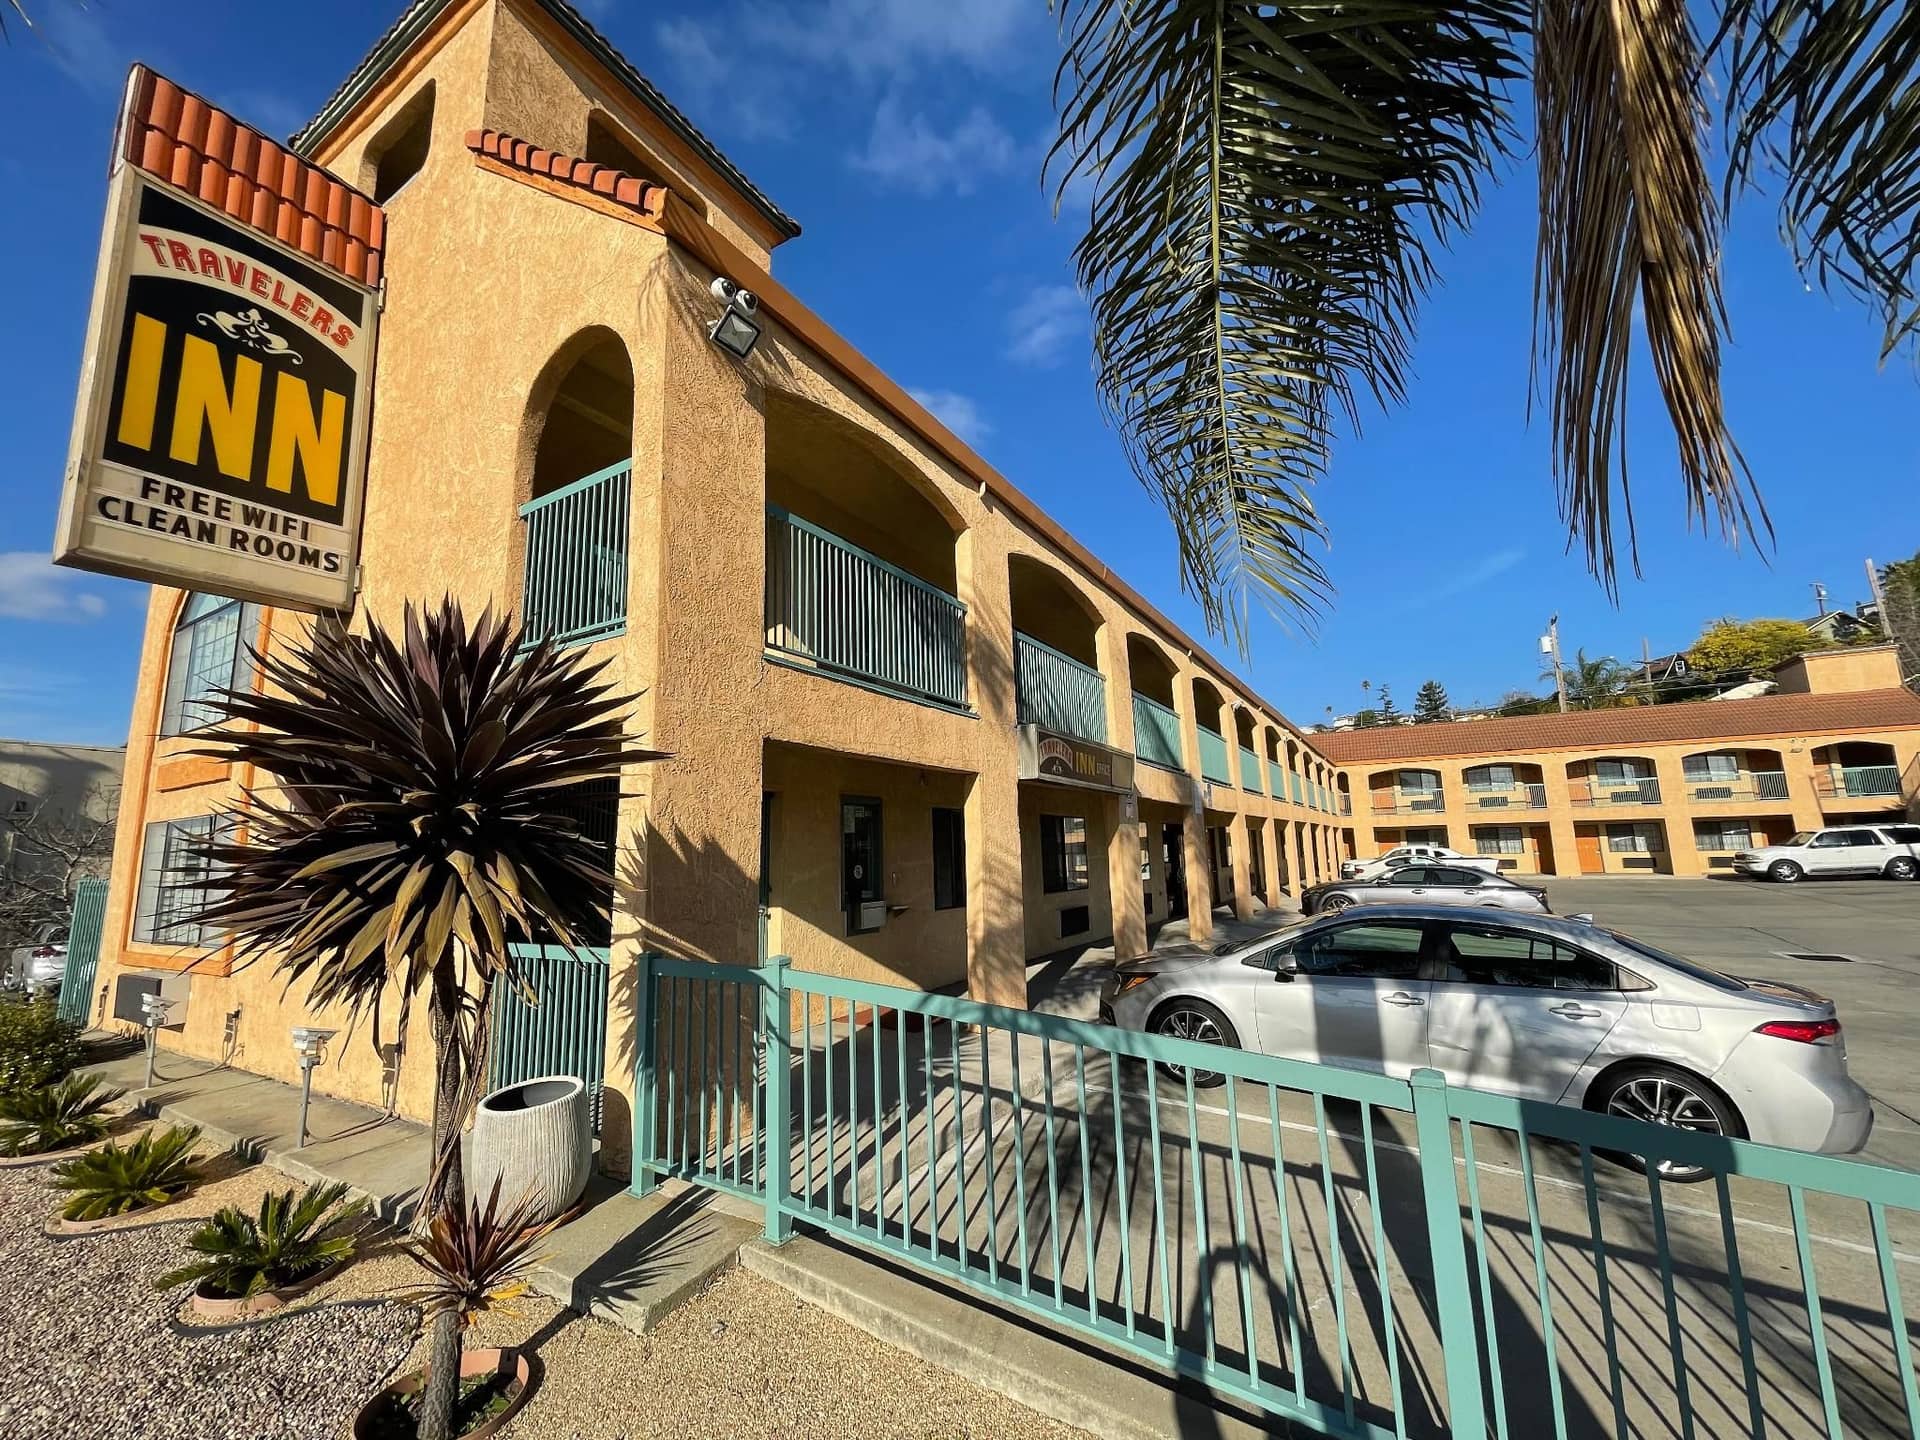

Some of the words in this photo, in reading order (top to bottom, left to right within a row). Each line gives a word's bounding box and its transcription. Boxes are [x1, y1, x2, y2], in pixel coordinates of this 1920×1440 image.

[139, 234, 355, 350] TRAVELERS
[118, 312, 347, 506] INN
[98, 496, 216, 545] CLEAN
[230, 528, 340, 573] ROOMS
[140, 477, 232, 521] FREE
[242, 504, 309, 541] WIFI
[1076, 752, 1096, 776] INN
